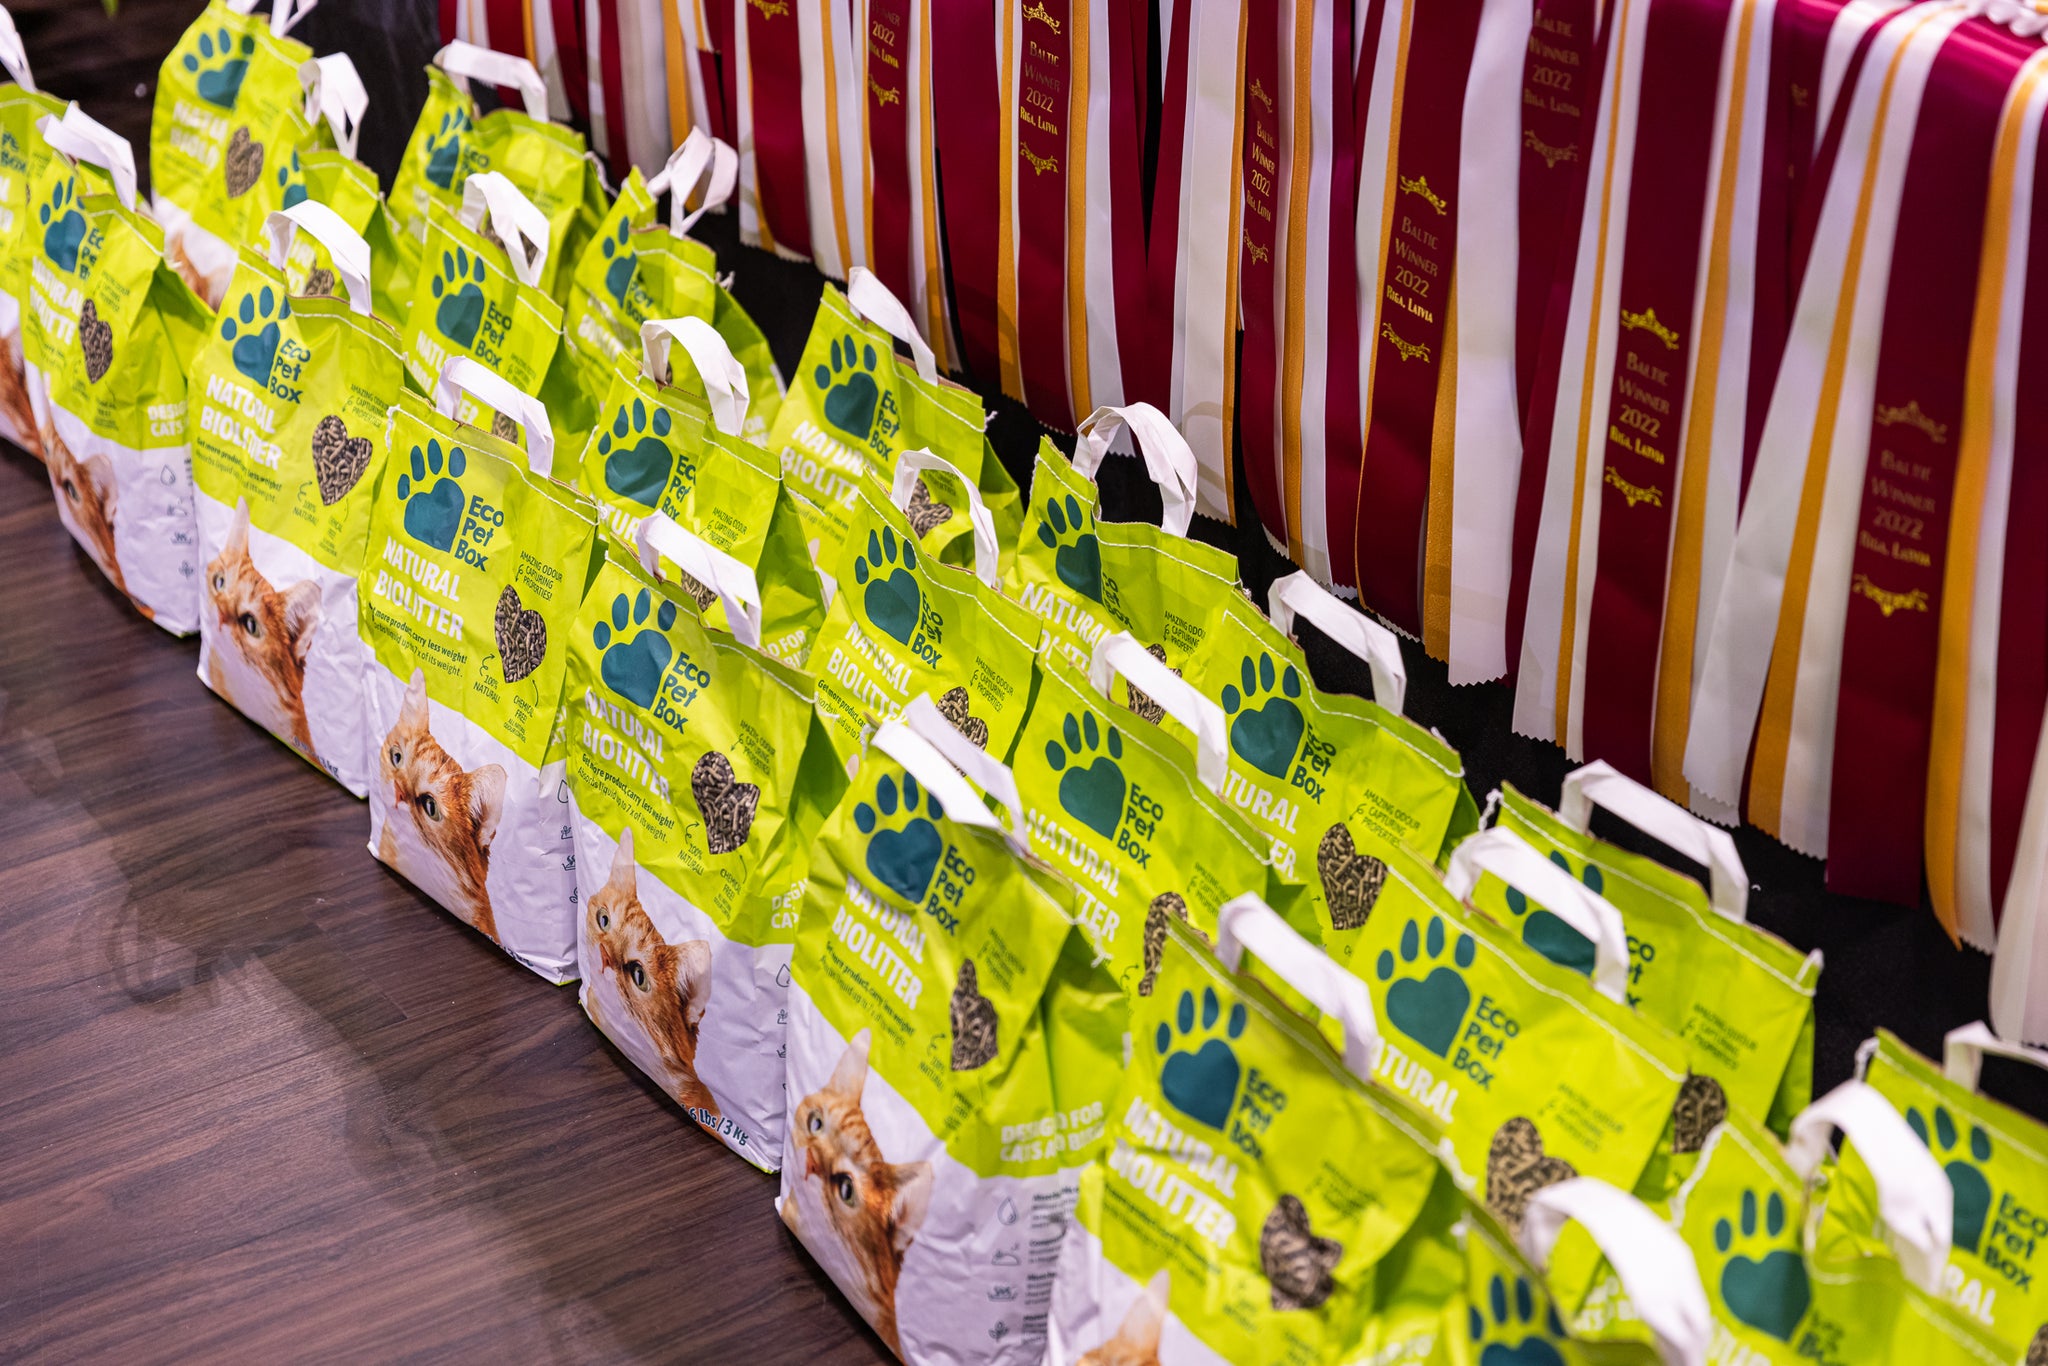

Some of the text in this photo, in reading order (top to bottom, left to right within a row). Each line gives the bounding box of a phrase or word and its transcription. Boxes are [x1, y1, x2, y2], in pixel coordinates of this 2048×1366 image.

[873, 21, 894, 47] 2022
[1030, 41, 1060, 68] BALTIC
[1025, 62, 1061, 93] WINNER
[1532, 64, 1572, 91] 2022
[1026, 87, 1054, 113] 2022
[1252, 142, 1276, 175] WINNER
[1251, 169, 1271, 197] 2022
[1401, 216, 1439, 250] BALTIC
[1395, 238, 1438, 277] WINNER
[1395, 265, 1430, 298] 2022
[1408, 298, 1433, 323] LATVIA
[280, 338, 311, 363] Eco
[482, 320, 505, 348] Pet
[273, 355, 302, 382] Pet
[475, 340, 502, 370] Box
[270, 376, 303, 405] Box
[1618, 376, 1670, 415] WINNER
[877, 409, 900, 438] Pet
[1619, 404, 1661, 438] 2022
[870, 430, 893, 462] Box
[669, 476, 693, 502] Pet
[468, 495, 505, 527] Eco
[1873, 506, 1924, 540] 2022
[461, 517, 494, 547] Pet
[382, 535, 461, 602] NATURAL
[454, 538, 489, 573] Box
[520, 551, 563, 583] AMAZING ODOUR
[523, 576, 553, 601] PROPERTIES!
[526, 566, 553, 589] CAPTURING
[373, 569, 464, 641] BIOLITTER
[1165, 611, 1187, 632] AMAZING
[428, 639, 441, 652] less
[441, 648, 468, 664] weight!
[844, 621, 913, 697] NATURAL
[911, 633, 942, 670] Box
[976, 656, 996, 680] AMAZING
[484, 674, 498, 690] 100%
[673, 652, 711, 689] Eco
[980, 673, 1005, 701] CAPTURING
[662, 674, 698, 707] Pet
[818, 680, 829, 692] Get
[829, 688, 841, 704] more
[585, 686, 664, 763] NATURAL
[654, 697, 689, 735] Box
[583, 720, 671, 804] BIOLITTER
[1300, 741, 1331, 777] Pet
[590, 763, 604, 777] more
[605, 772, 628, 793] product,
[627, 789, 641, 806] carry
[652, 812, 675, 829] weight!
[599, 782, 617, 800] liquid
[1291, 765, 1325, 804] Box
[1130, 782, 1164, 822] Eco
[1125, 807, 1156, 842] Pet
[945, 845, 975, 886] Eco
[1025, 808, 1122, 898] NATURAL
[1117, 828, 1153, 870] Box
[936, 871, 964, 907] Pet
[846, 872, 926, 964] NATURAL
[925, 893, 960, 936] Box
[832, 904, 923, 1010] BIOLITTER
[1475, 995, 1520, 1039] Eco
[1464, 1022, 1504, 1060] Pet
[1453, 1046, 1495, 1091] Box
[1070, 1101, 1104, 1129] FOR
[1123, 1095, 1240, 1199] NATURAL
[1985, 1246, 2033, 1294] Box
